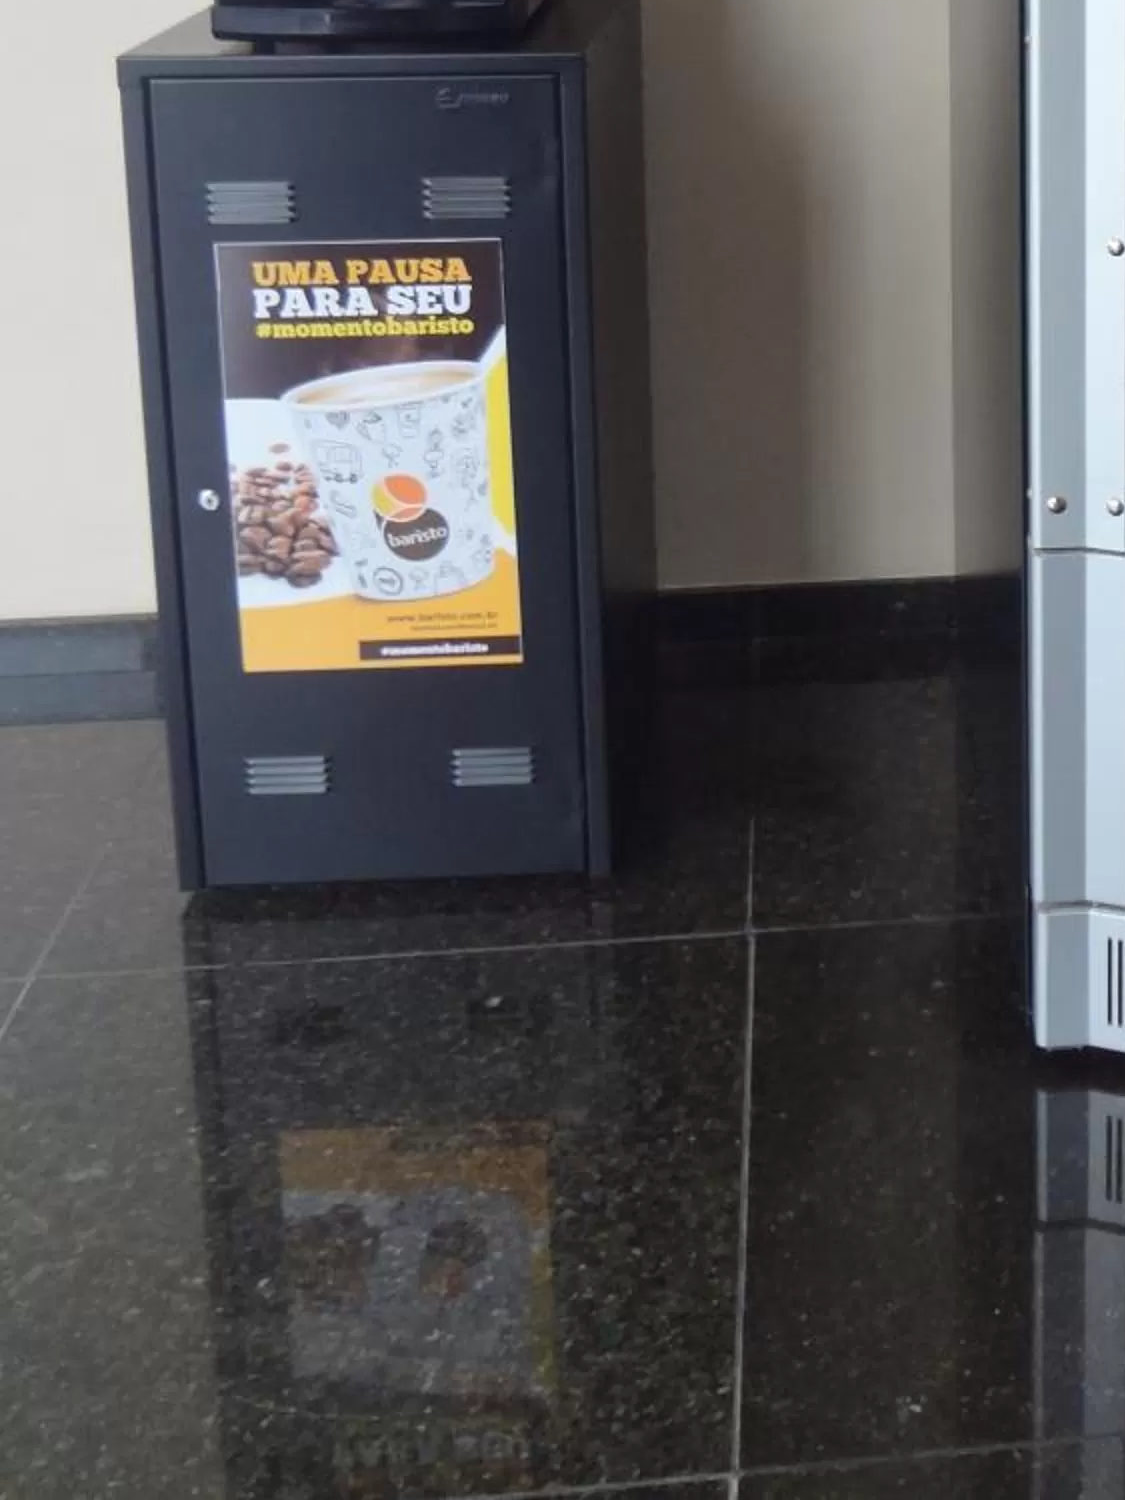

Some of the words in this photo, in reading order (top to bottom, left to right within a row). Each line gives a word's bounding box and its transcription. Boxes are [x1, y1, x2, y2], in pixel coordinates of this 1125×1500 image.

[252, 260, 339, 288] UMA
[346, 257, 472, 285] PAUSA
[252, 287, 378, 319] PARA
[386, 285, 473, 317] SEU
[256, 315, 475, 339] #momentobaristo
[387, 526, 447, 548] baristo
